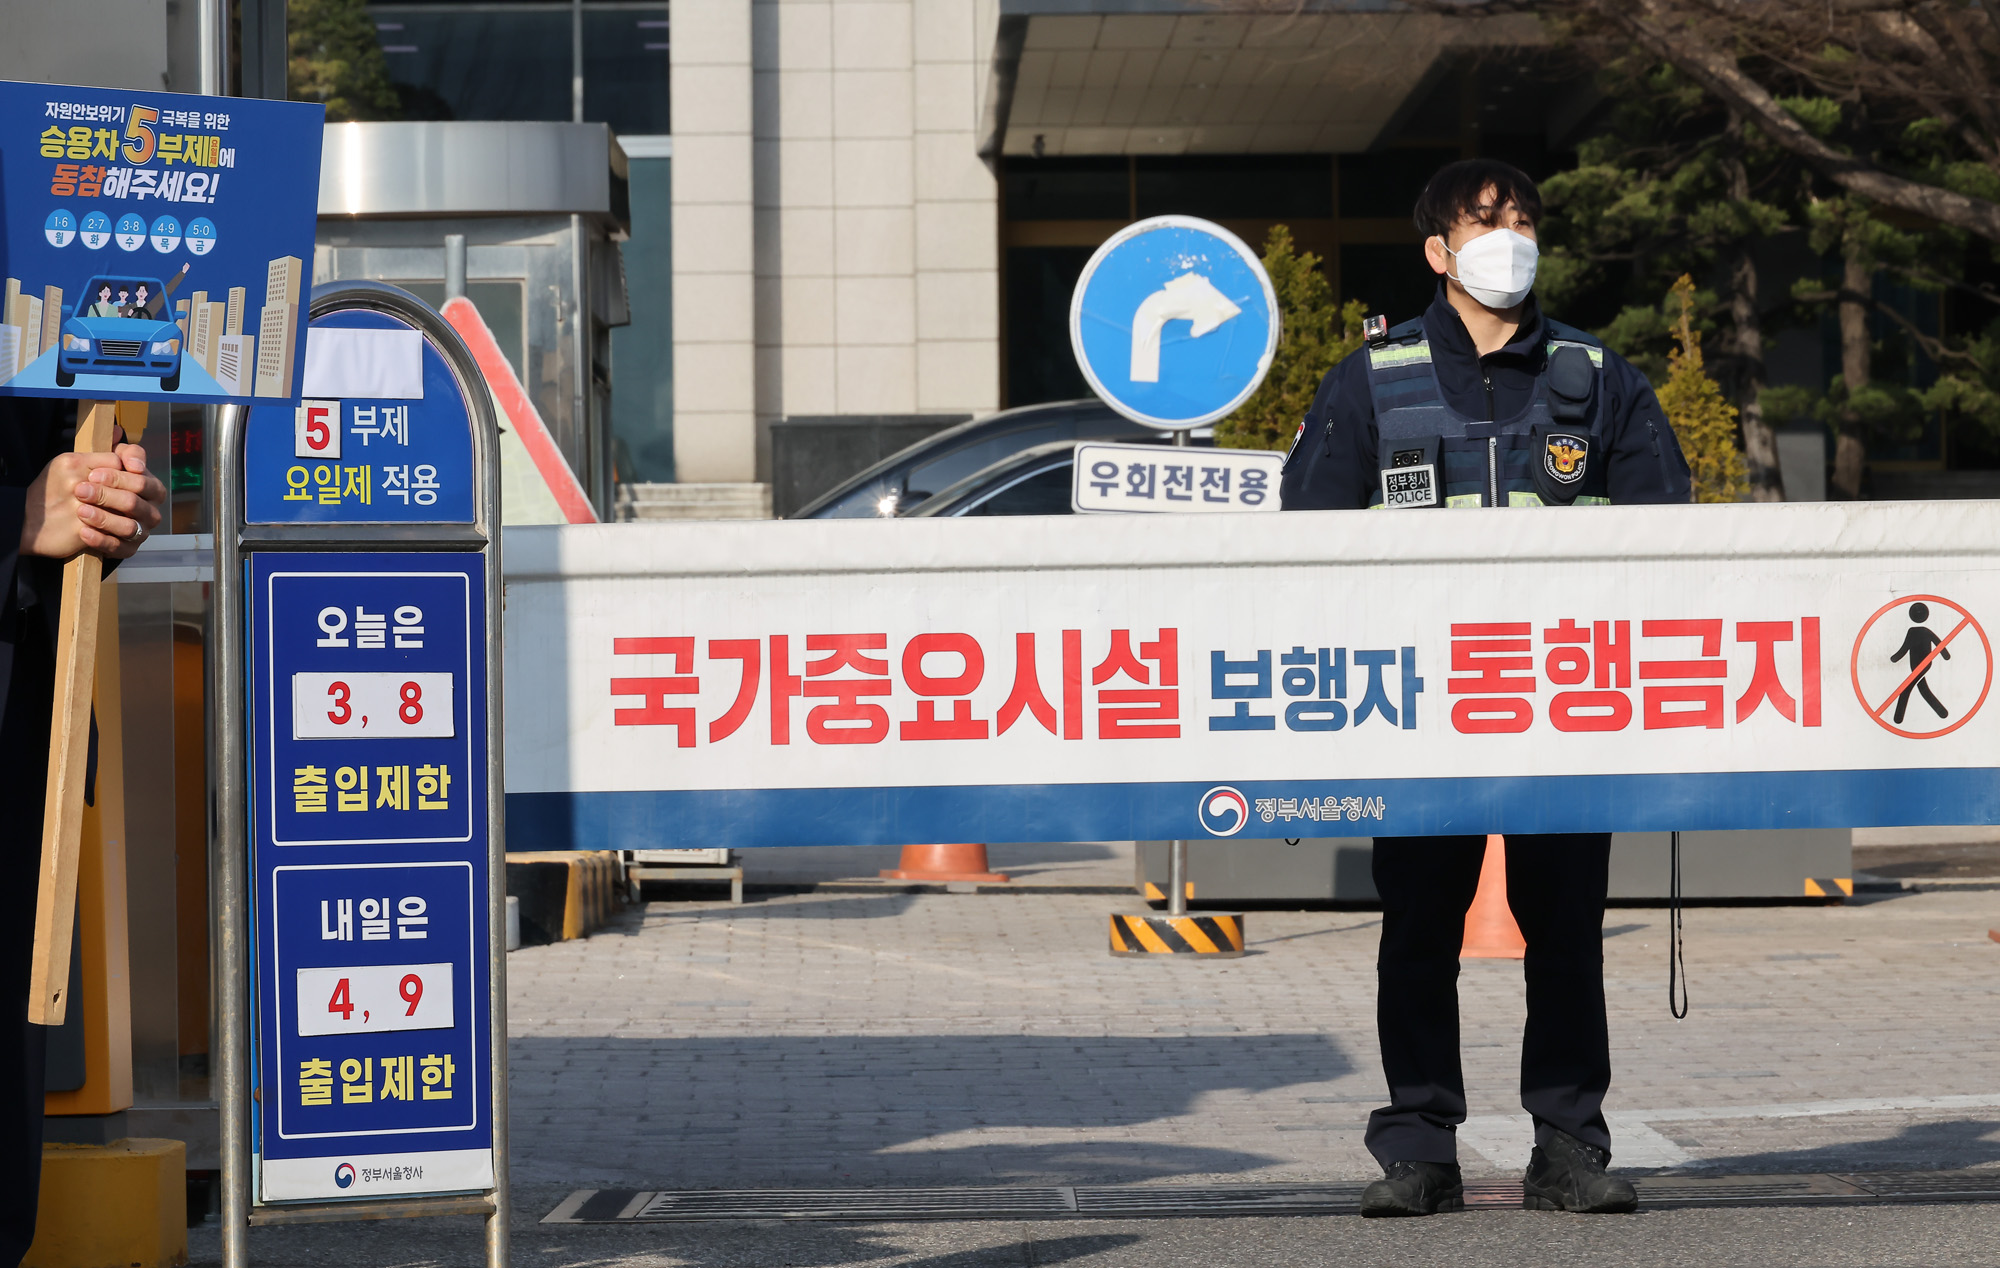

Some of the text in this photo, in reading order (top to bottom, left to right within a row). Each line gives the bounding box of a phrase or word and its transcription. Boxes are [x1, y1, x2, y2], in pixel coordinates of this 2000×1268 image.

[45, 101, 230, 131] 자원안보위기 극복을 위한
[55, 232, 205, 252] 월 화 수 목 금
[305, 405, 409, 451] 5 부제
[283, 463, 441, 506] 요일제 적용
[1090, 461, 1268, 505] 우회전전용
[1388, 471, 1429, 492] 정부청사
[1388, 489, 1432, 504] POLICE
[316, 605, 425, 649] 오늘은
[610, 616, 1823, 748] 국가중요시설 보행자 통행금지
[293, 763, 452, 813] 출입제한
[1255, 796, 1386, 823] 정부서울청사
[320, 896, 429, 941] 내일은
[299, 1053, 456, 1106] 출입제한
[361, 1165, 424, 1183] 정부서울청사
